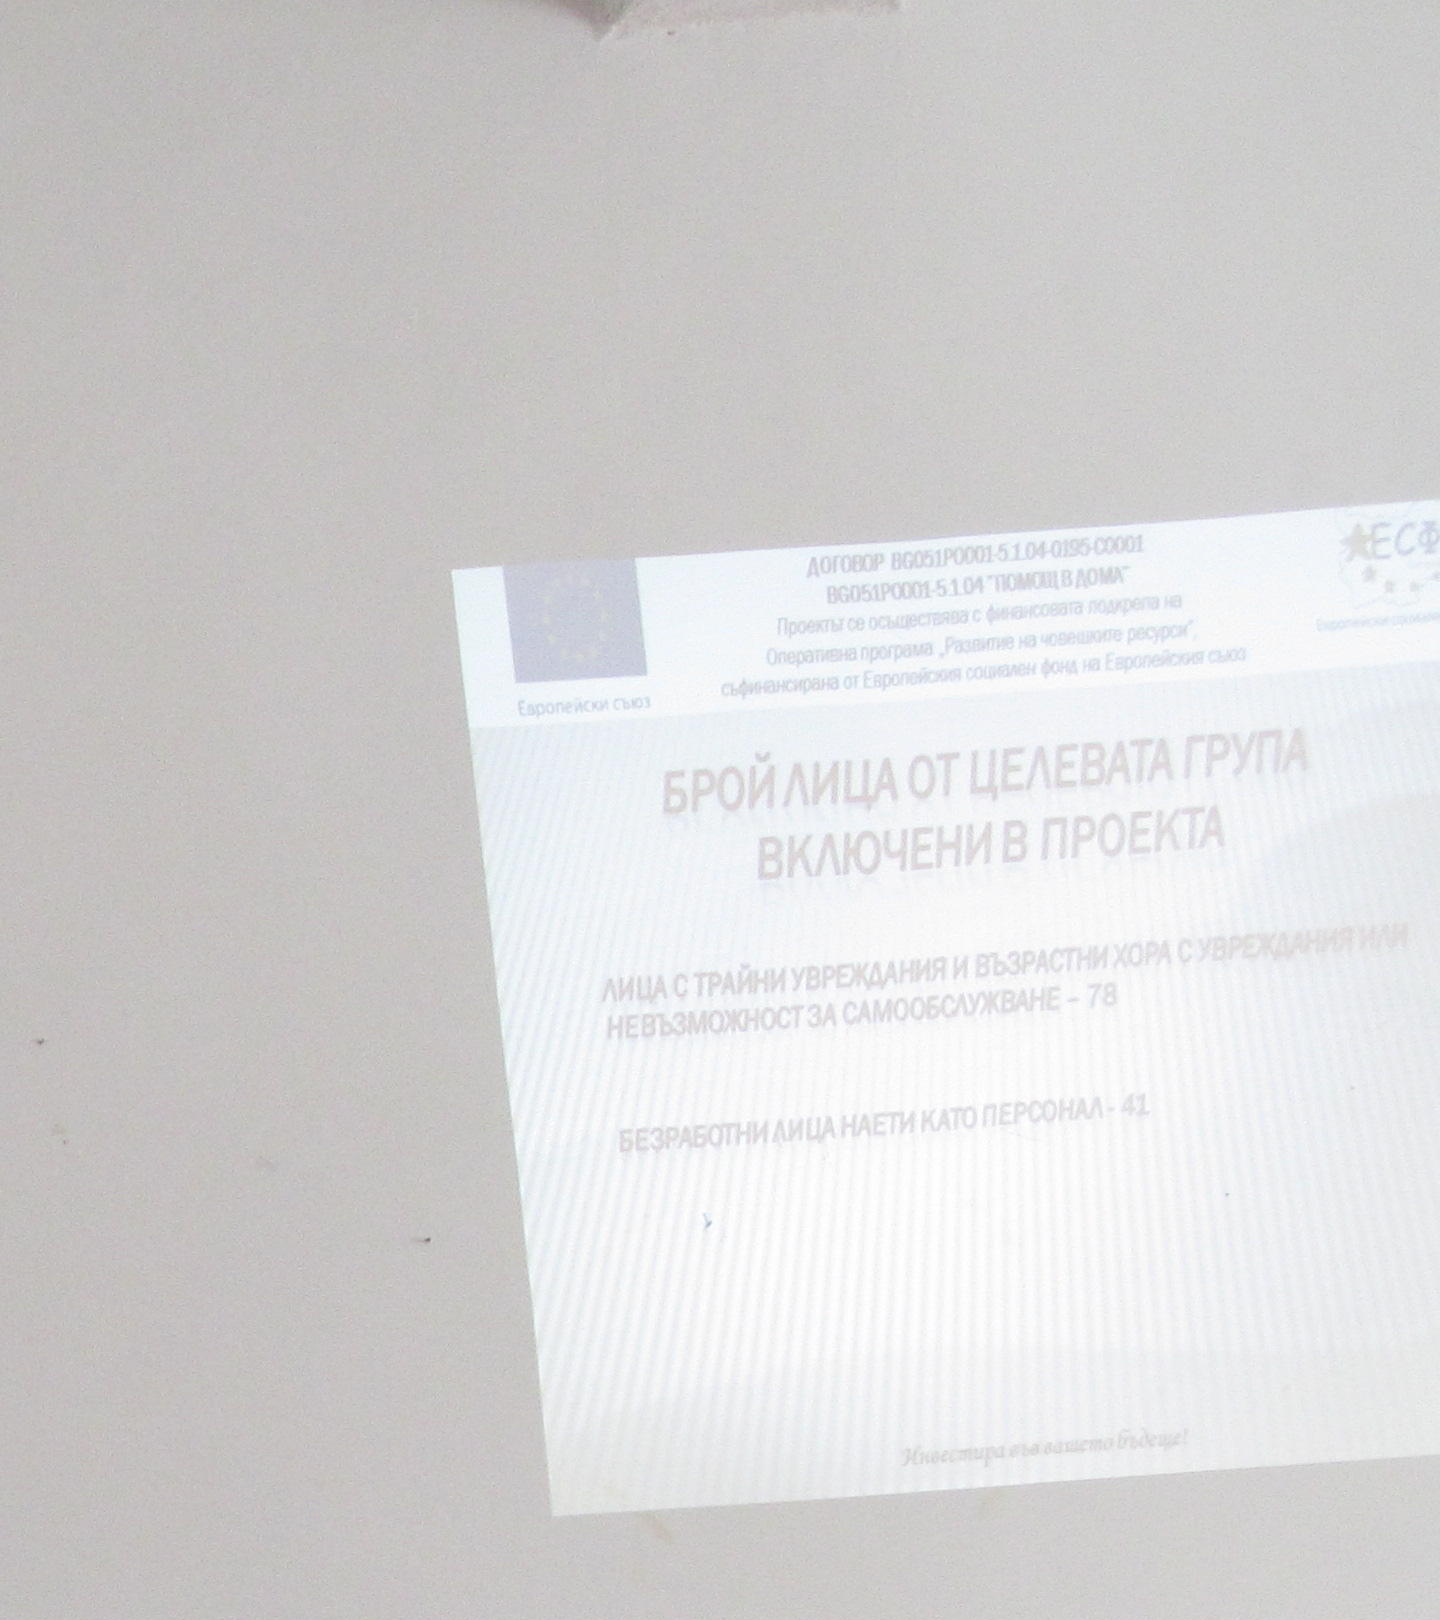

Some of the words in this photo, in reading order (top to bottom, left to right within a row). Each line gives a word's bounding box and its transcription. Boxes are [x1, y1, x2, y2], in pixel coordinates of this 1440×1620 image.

[806, 553, 885, 578] ДОГОВОР
[847, 617, 866, 632] се
[1164, 593, 1183, 609] на
[720, 675, 840, 699] съфинансирана
[843, 672, 860, 690] от
[863, 667, 962, 691] Европейския
[965, 660, 1037, 681] социален
[1040, 657, 1078, 679] фонд
[1083, 657, 1101, 673] на
[1105, 649, 1205, 673] Европейския
[766, 645, 857, 667] Оперативна
[860, 641, 933, 663] програма
[1018, 633, 1037, 649] на
[517, 697, 610, 718] Европейски
[612, 696, 652, 711] съюз
[662, 752, 776, 815] БРОЙ
[781, 756, 899, 810] ЛИЦА
[907, 752, 960, 800] ОТ
[968, 737, 1174, 801] ЦЕЛЕВАТА
[1181, 728, 1309, 780] ГРУПА
[756, 822, 993, 880] ВКЛЮЧЕНИ
[1001, 819, 1029, 864] В
[1039, 805, 1226, 861] ПРОЕКТА
[601, 975, 668, 1005] ЛИЦА
[673, 972, 689, 998] С
[693, 963, 787, 997] ТРАЙНИ
[790, 957, 947, 992] УВРЕЖДАНИЯ
[953, 955, 970, 981] И
[974, 944, 1109, 978] ВЪЗРАСТНИ
[1112, 940, 1172, 970] ХОРА
[1177, 938, 1194, 962] С
[1197, 926, 1353, 963] УВРЕЖДАНИЯ
[606, 1005, 805, 1040] НЕВЪЗМОЖНОСТ
[807, 1002, 838, 1028] ЗА
[842, 986, 1061, 1025] САМООБСЛУЖВАНЕ
[1088, 982, 1118, 1009] 78
[618, 1120, 770, 1154] БЕЗРАБОТНИ
[772, 1114, 837, 1145] ЛИЦА
[840, 1110, 916, 1138] НАЕТИ
[920, 1104, 978, 1132] КАТО
[981, 1096, 1105, 1128] ПЕРСОНАЛ
[1119, 1092, 1151, 1117] 41
